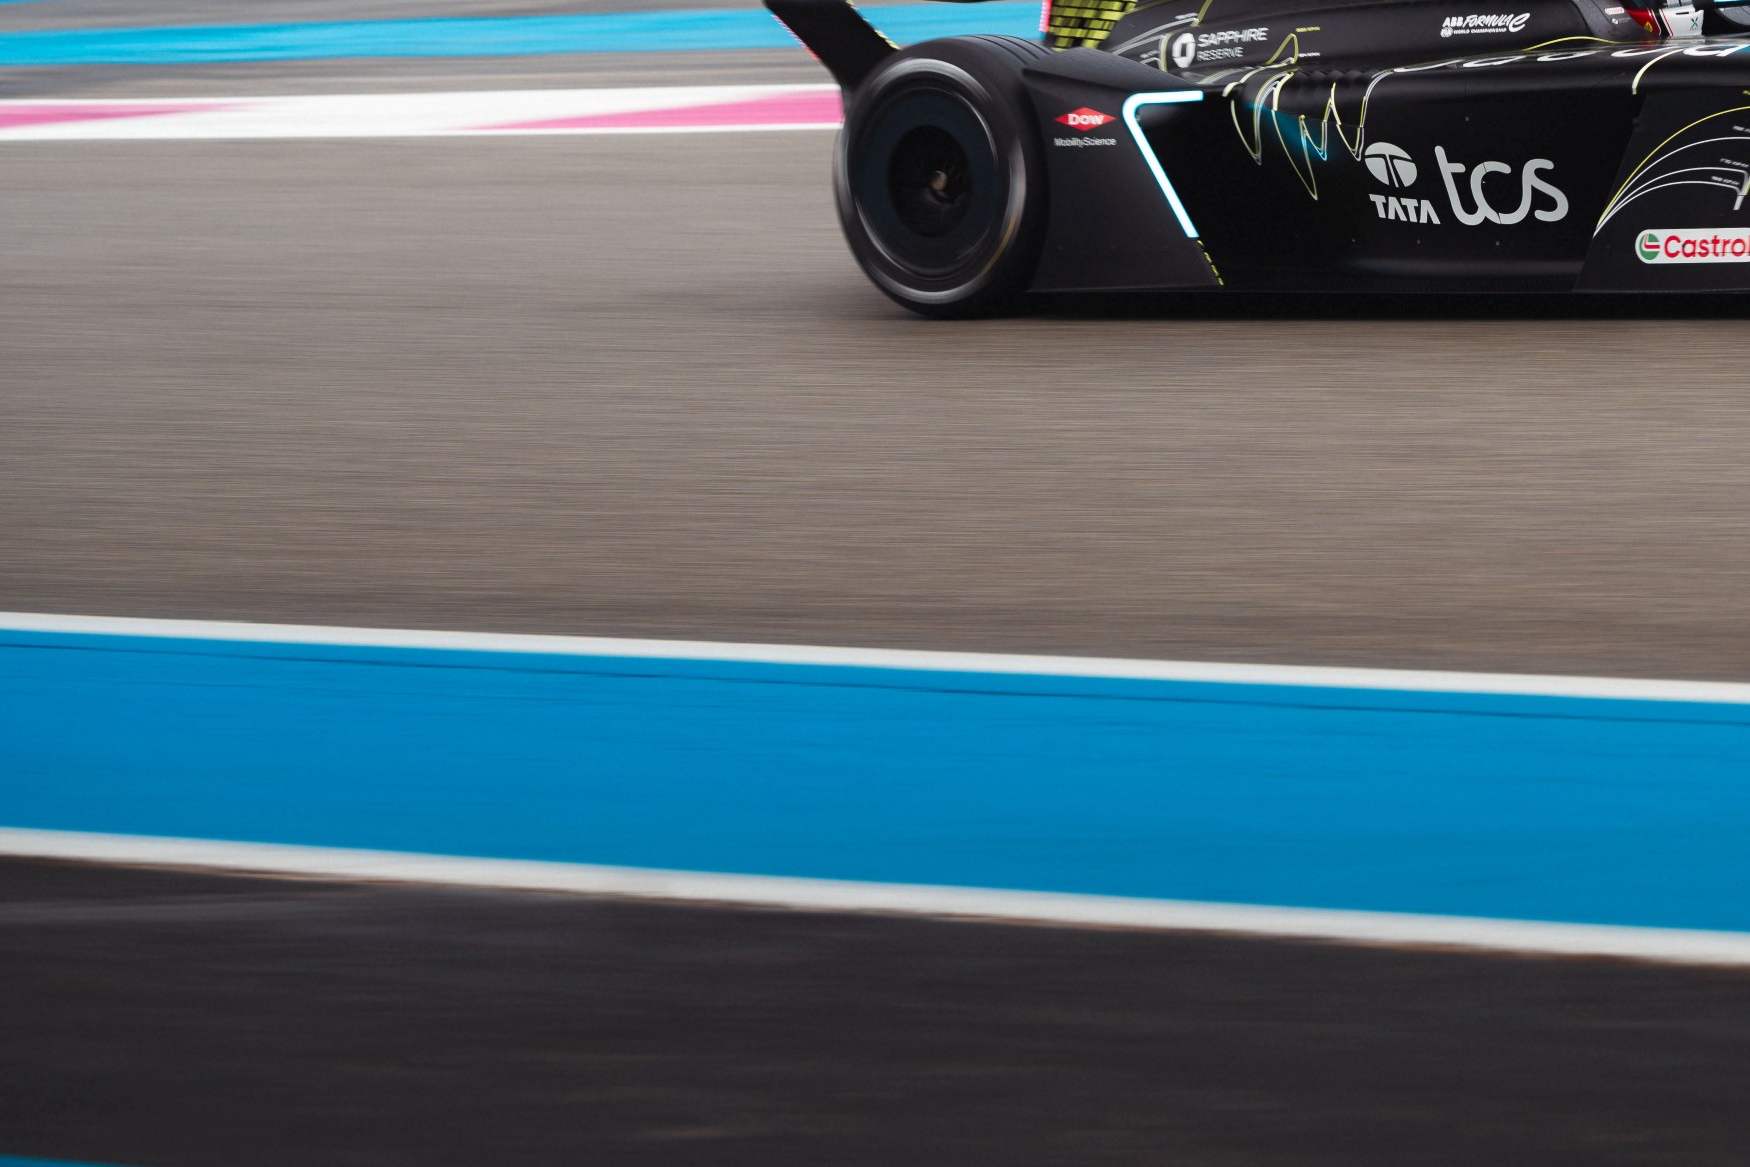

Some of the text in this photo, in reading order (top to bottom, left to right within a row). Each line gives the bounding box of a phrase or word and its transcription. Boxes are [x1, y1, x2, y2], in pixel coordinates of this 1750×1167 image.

[1442, 17, 1464, 27] ABB
[1462, 14, 1514, 28] FORMULA
[1197, 27, 1269, 48] SAPPHIRE
[1197, 46, 1244, 61] RESERVE
[1068, 113, 1104, 126] DOW
[1369, 145, 1569, 226] TATA tcs
